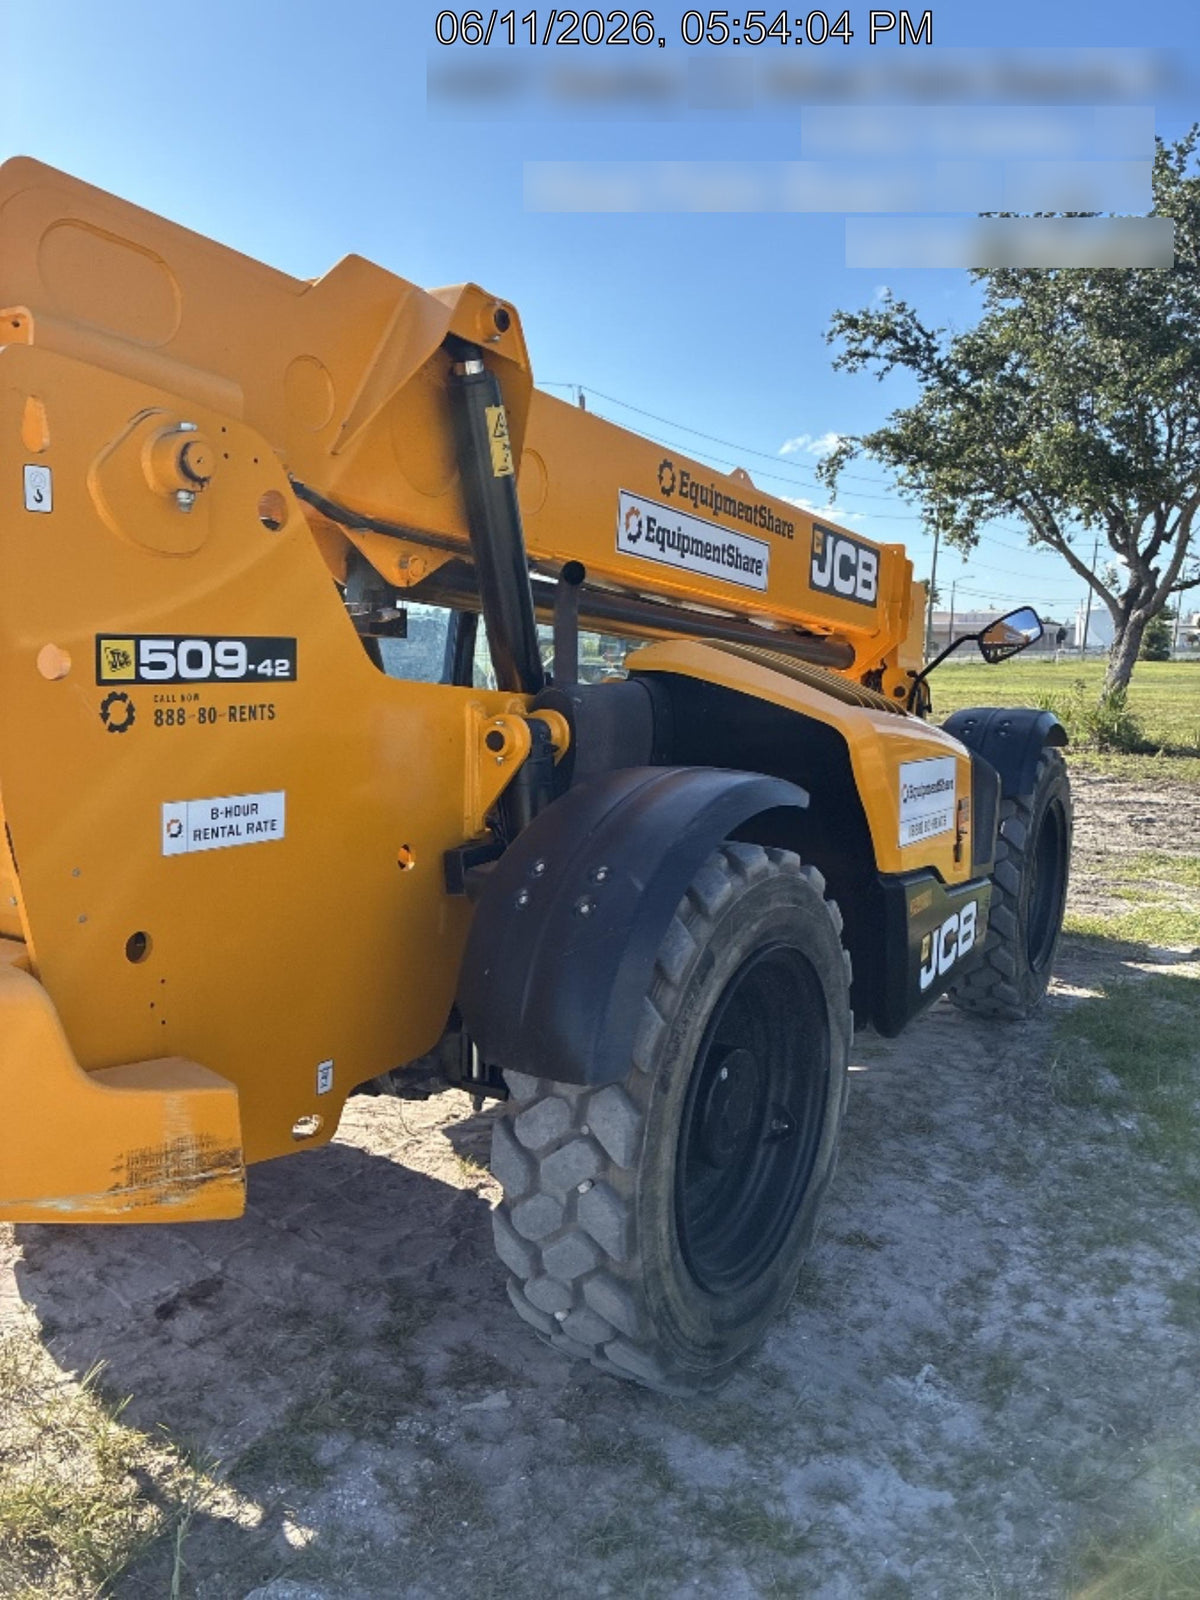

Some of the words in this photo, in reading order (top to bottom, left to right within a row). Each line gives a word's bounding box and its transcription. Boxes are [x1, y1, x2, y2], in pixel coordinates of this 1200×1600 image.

[678, 469, 794, 540] EquipmentShare
[644, 515, 764, 577] EquipmentShare
[812, 534, 878, 602] JCB
[139, 639, 291, 680] 509-42
[192, 824, 242, 842] RENTAL
[246, 819, 278, 835] RATE
[920, 900, 977, 990] JCB
